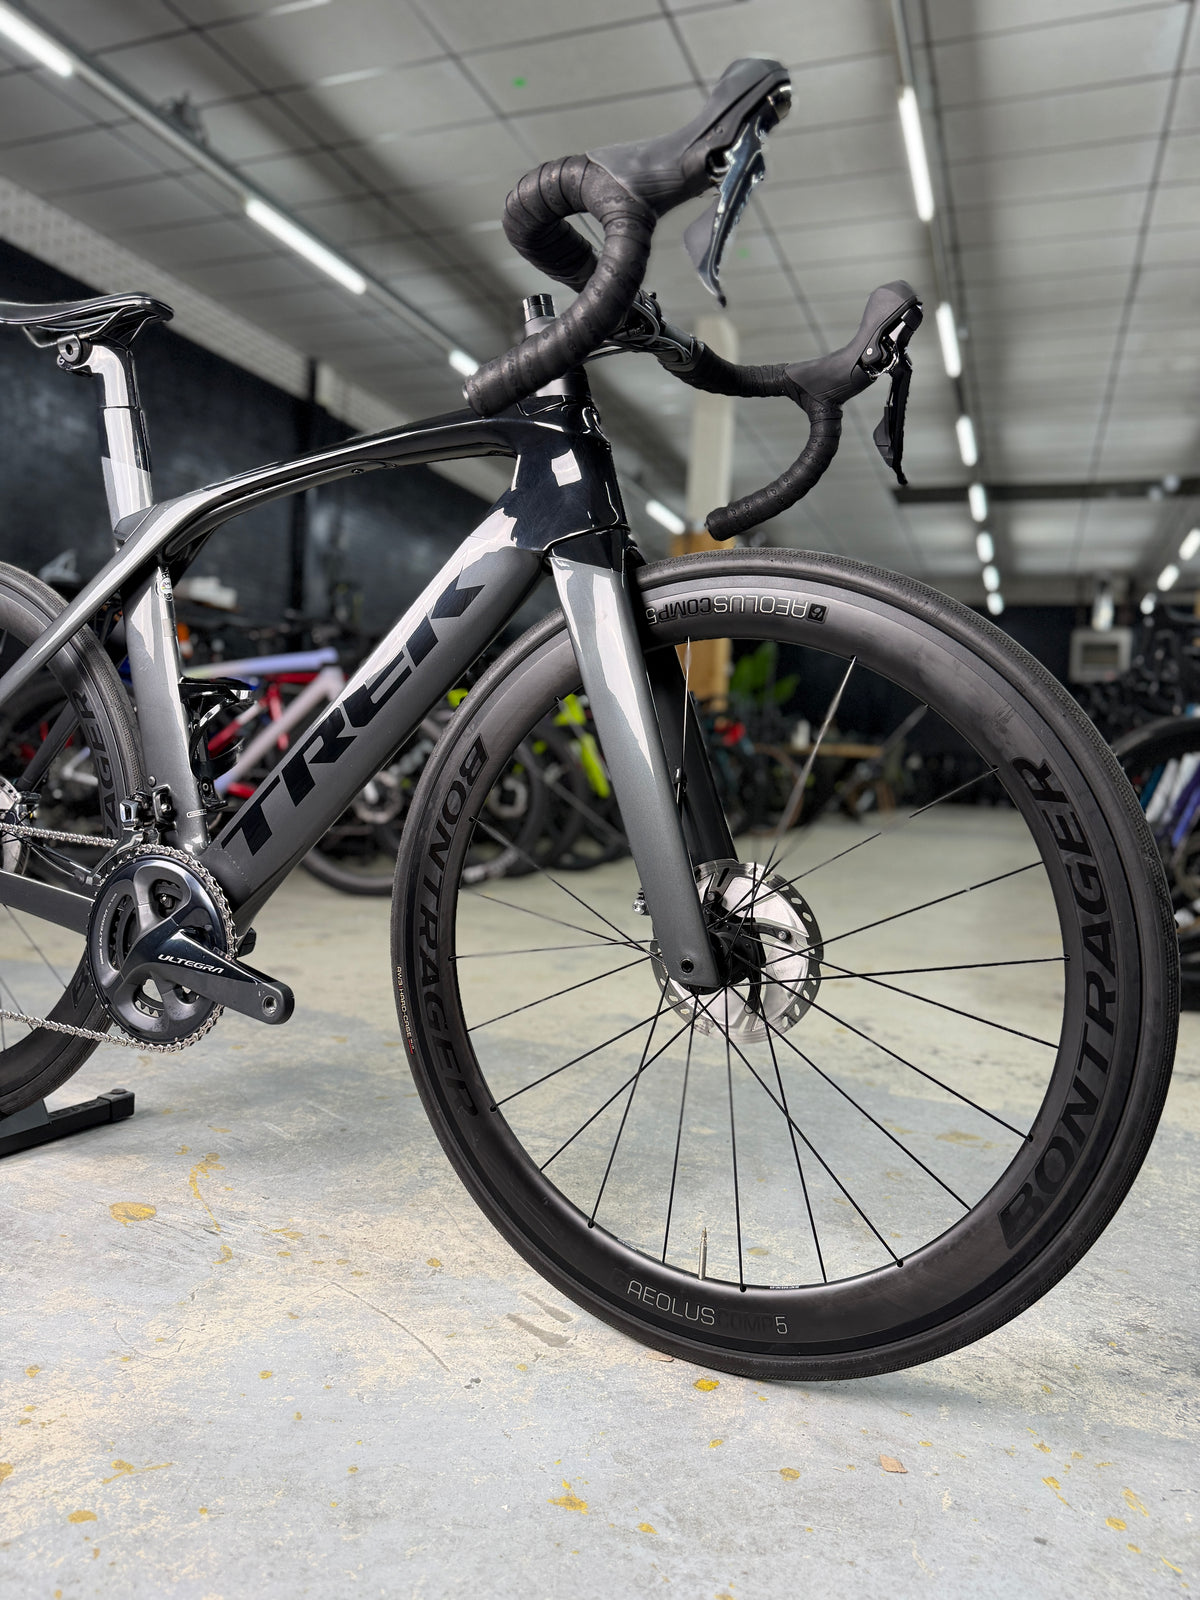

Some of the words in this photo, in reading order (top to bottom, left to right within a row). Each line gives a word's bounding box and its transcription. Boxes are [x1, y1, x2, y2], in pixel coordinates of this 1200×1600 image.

[220, 568, 487, 857] TREK
[157, 953, 225, 975] ULTEGRA
[417, 732, 490, 1118] BONTRAGER
[997, 756, 1118, 1249] BONTRAGER
